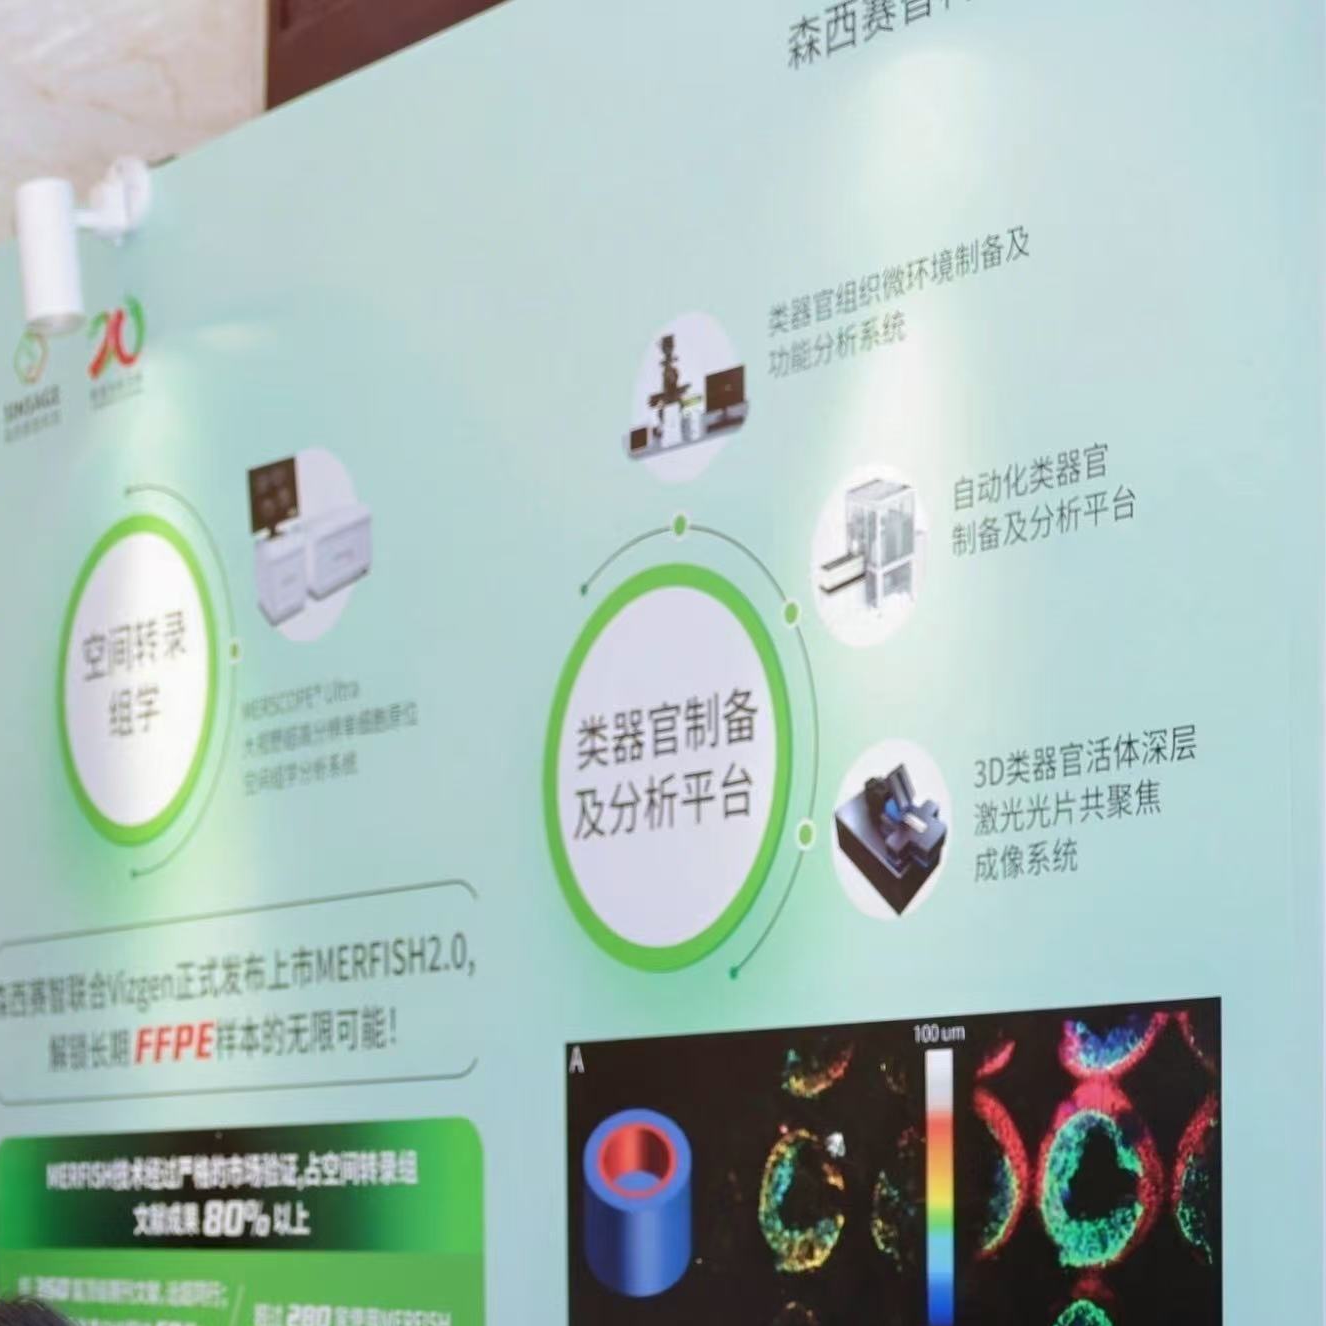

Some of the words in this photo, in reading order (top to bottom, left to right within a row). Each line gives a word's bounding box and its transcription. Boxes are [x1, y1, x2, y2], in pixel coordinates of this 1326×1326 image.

[768, 225, 1030, 337] 类器官组织微环境制备及
[767, 310, 906, 378] 功能分析系统
[953, 442, 1109, 511] 自动化类器官
[950, 485, 1137, 557] 制备及分析平台
[83, 610, 186, 682] 空间转录
[109, 686, 160, 736] 组学
[577, 687, 758, 770] 类器官制备
[973, 724, 1197, 789] 3D类器官活体深层
[573, 762, 753, 840] 及分析平台
[973, 779, 1161, 837] 激光光片共聚焦
[974, 837, 1078, 883] 成像系统
[134, 1020, 215, 1065] FFPE
[568, 1045, 585, 1073] A
[913, 1023, 940, 1044] 100
[202, 1198, 271, 1238] 80%
[273, 1201, 311, 1236] 以上
